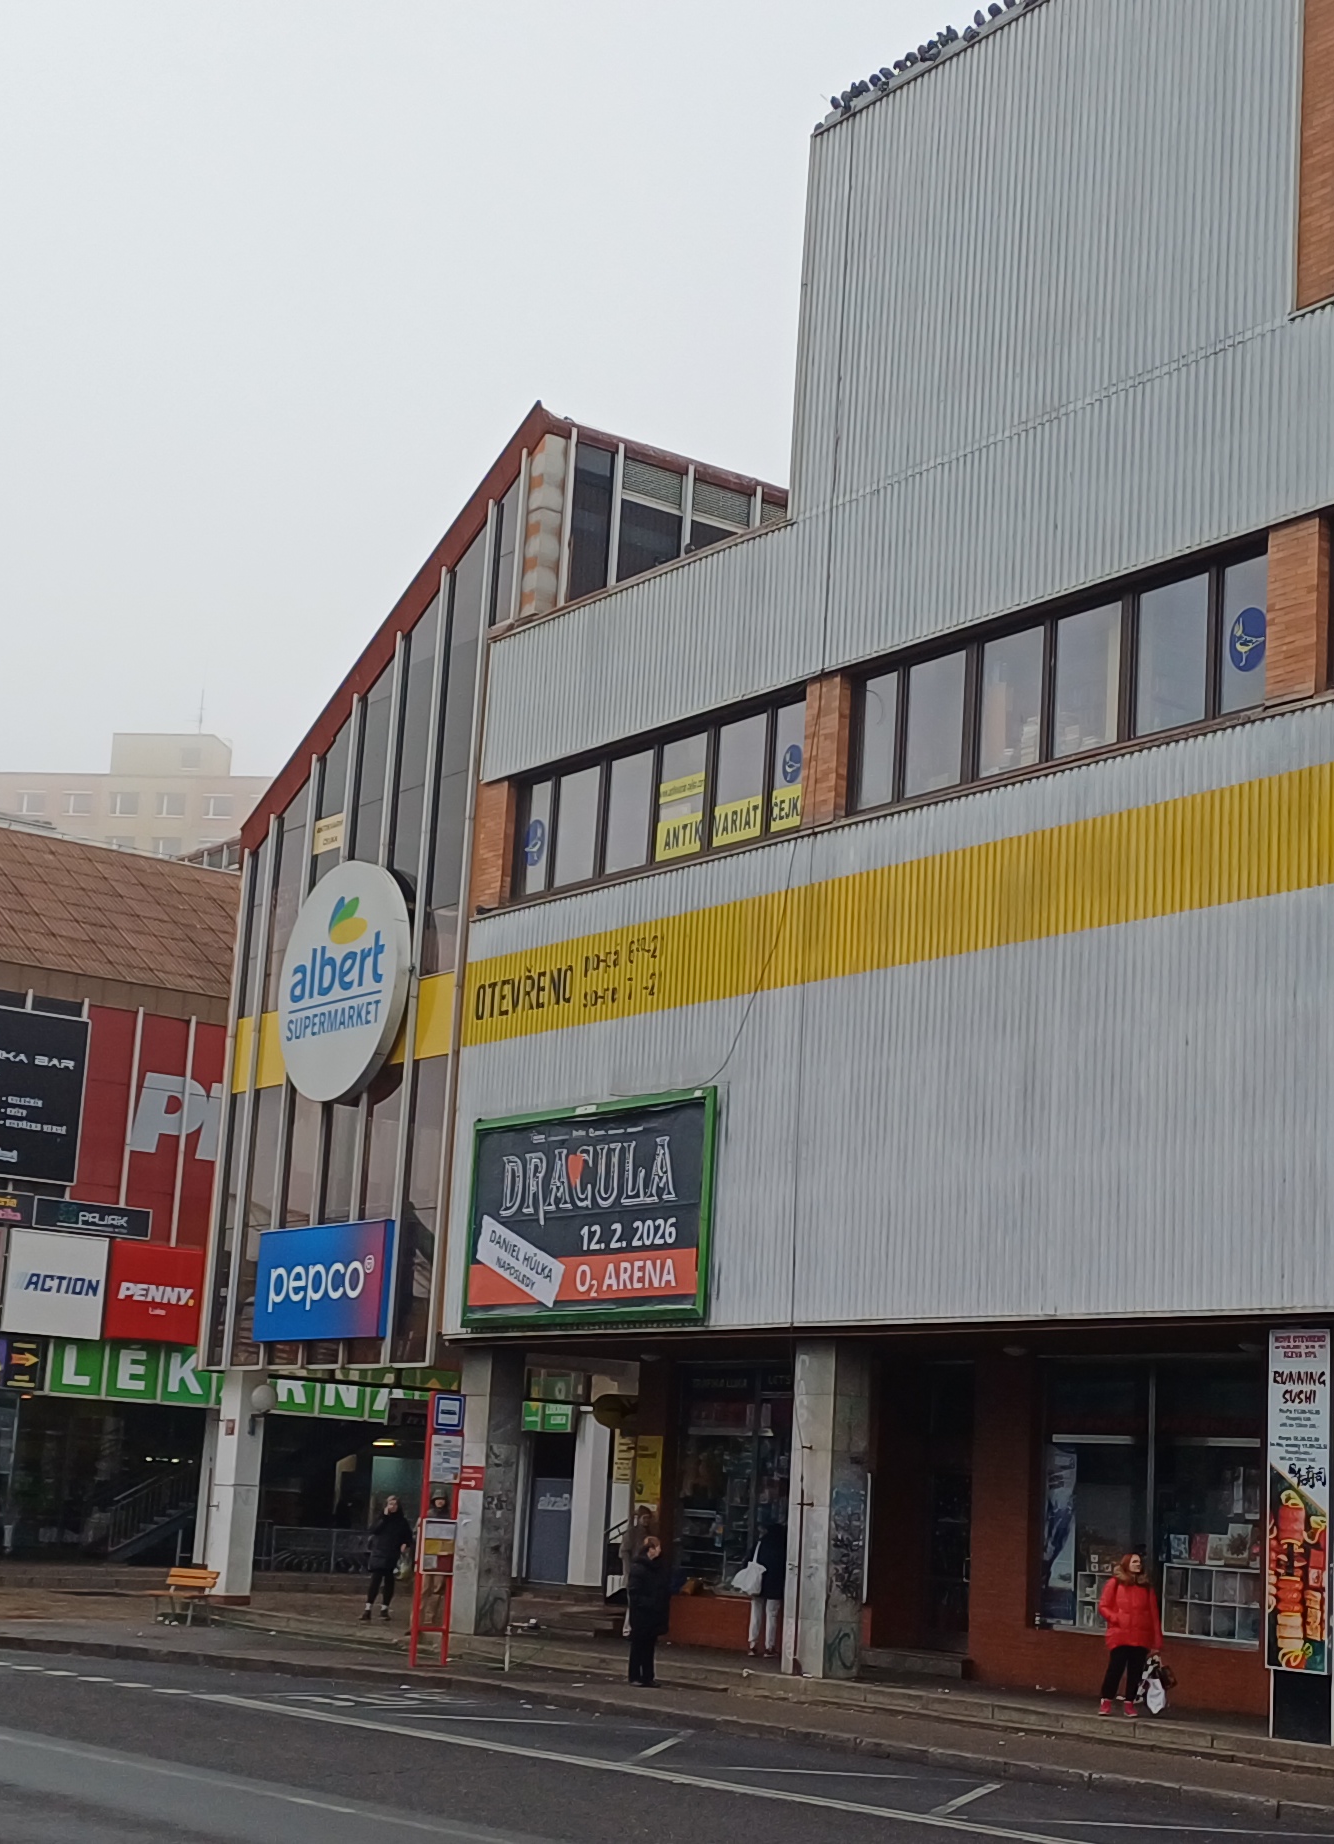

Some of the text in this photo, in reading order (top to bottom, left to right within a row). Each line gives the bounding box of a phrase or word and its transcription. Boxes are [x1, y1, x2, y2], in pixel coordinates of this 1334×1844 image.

[289, 930, 385, 1004] albert
[475, 965, 573, 1021] OTEVŘENO
[286, 999, 381, 1042] SUPERMARKET
[34, 1055, 75, 1070] BAR
[499, 1136, 679, 1227] DRACULA
[580, 1217, 677, 1250] 12. 2. 2026
[489, 1229, 553, 1284] DANIEL HŮLKA
[602, 1258, 677, 1291] ARENA
[23, 1272, 101, 1298] ACTION
[267, 1260, 365, 1313] pepco
[1272, 1370, 1327, 1388] RUNNING
[1281, 1388, 1317, 1405] SUSHI
